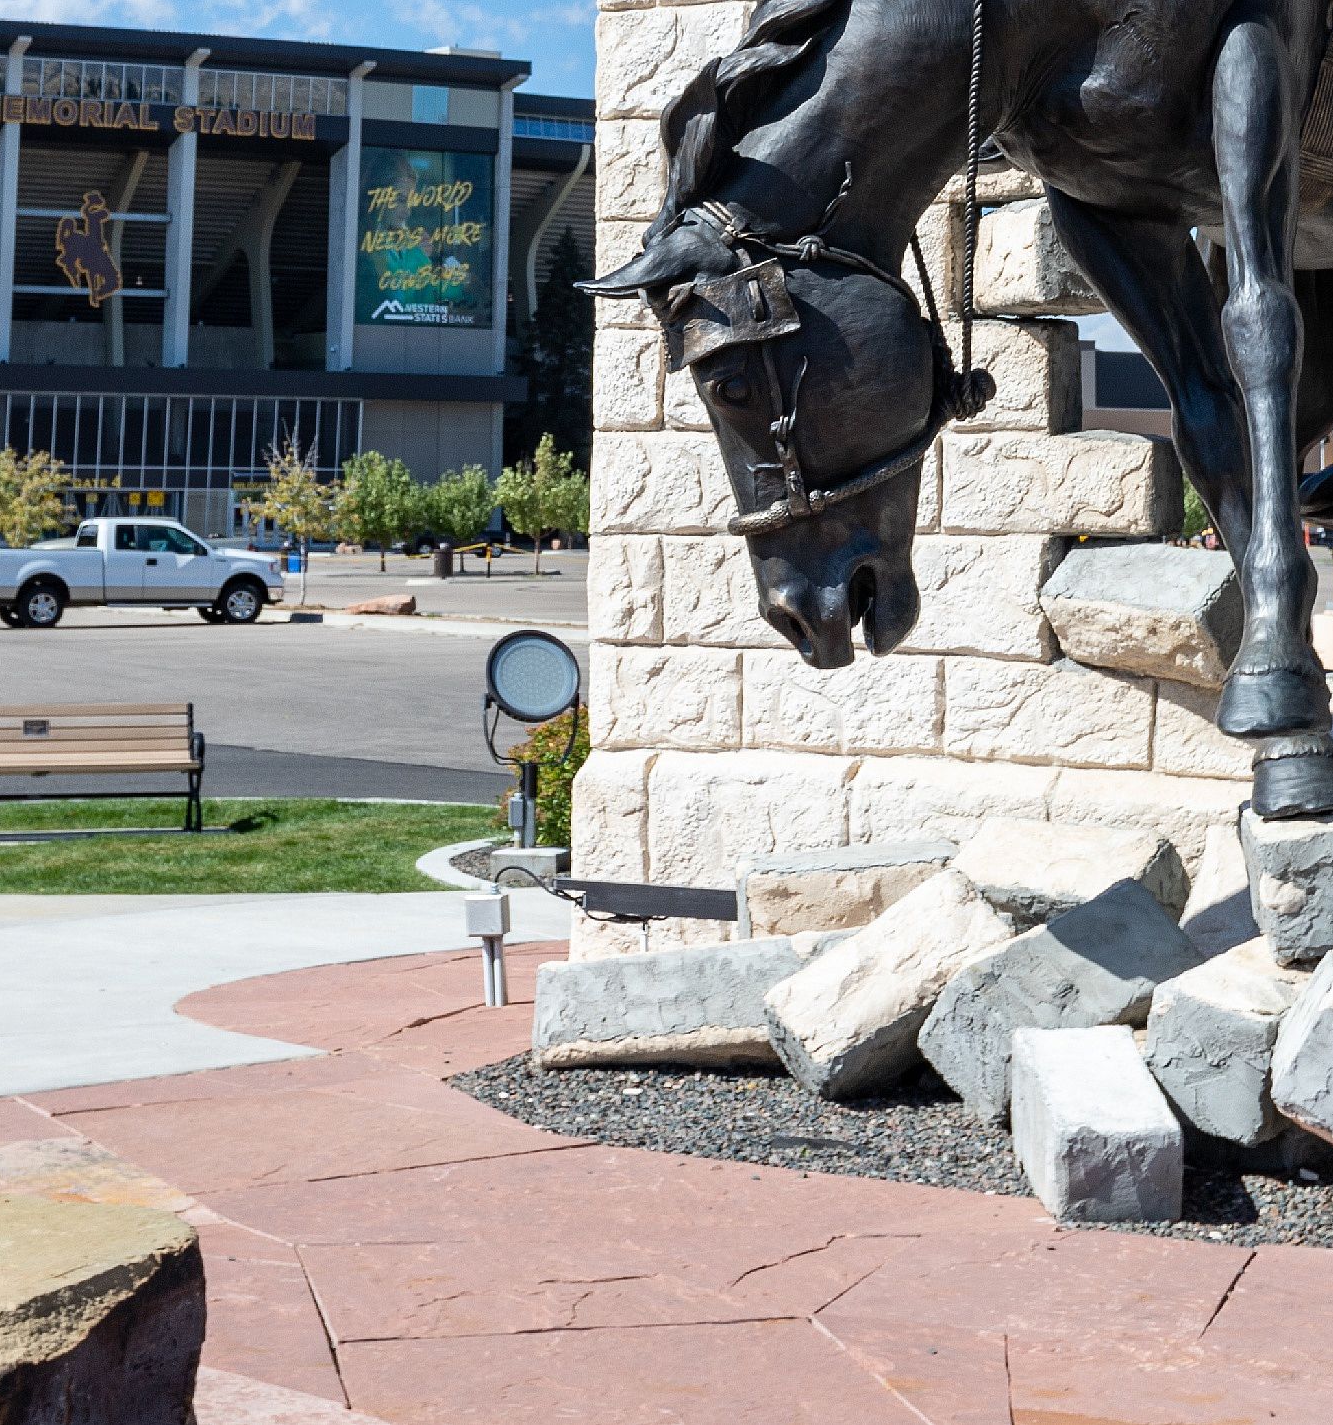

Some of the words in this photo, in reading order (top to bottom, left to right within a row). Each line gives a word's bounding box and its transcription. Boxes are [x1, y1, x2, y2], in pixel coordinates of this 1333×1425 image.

[173, 106, 316, 141] STADIUM
[367, 186, 401, 215] THE
[407, 181, 474, 213] WORLD
[361, 227, 424, 252] NEEDS
[430, 223, 483, 248] MORE
[379, 264, 470, 292] COWBOYS
[404, 304, 448, 314] WESTERN
[413, 313, 448, 324] STATES
[449, 314, 475, 324] BANK
